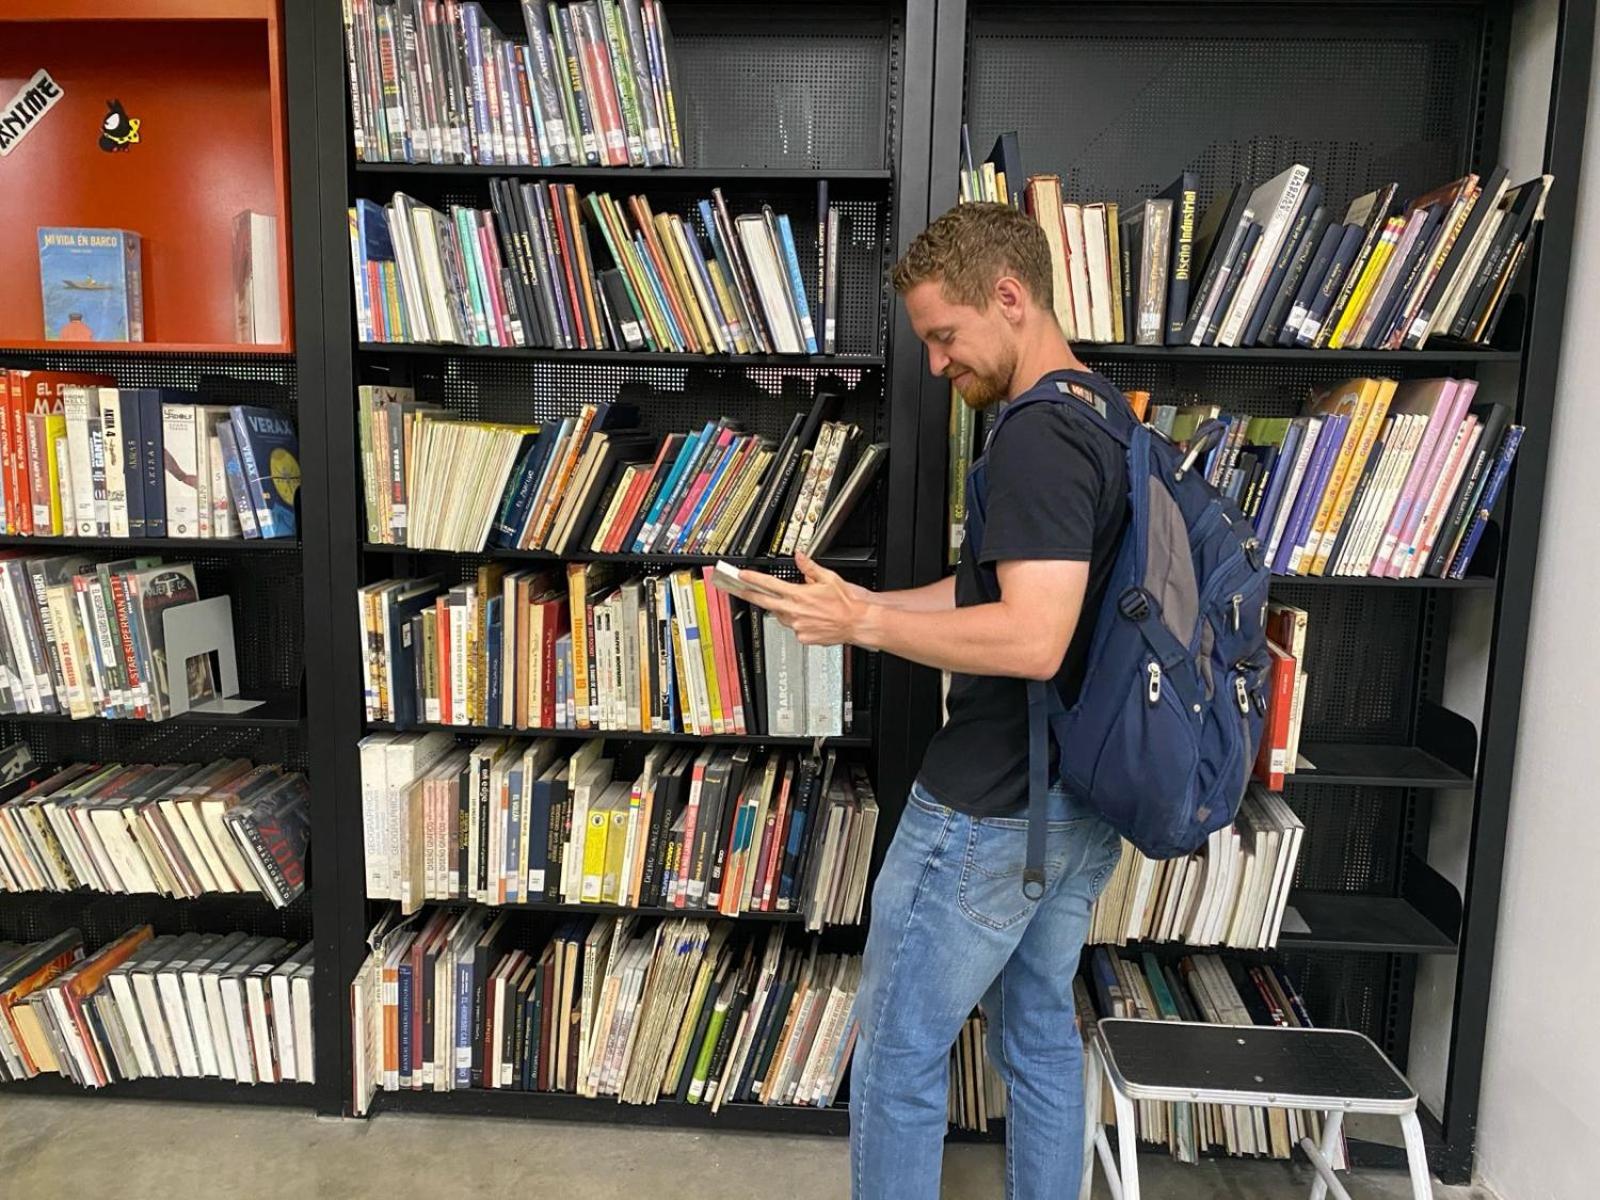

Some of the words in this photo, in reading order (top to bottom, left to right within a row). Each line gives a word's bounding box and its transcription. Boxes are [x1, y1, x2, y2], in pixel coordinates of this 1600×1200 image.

[401, 13, 416, 50] METAL
[566, 55, 582, 91] BATMAN
[0, 77, 60, 148] ANIME
[1179, 190, 1198, 243] Industrial
[44, 235, 55, 248] MI
[56, 234, 75, 247] VIDA
[77, 234, 89, 247] EN
[90, 235, 117, 247] BARCO
[818, 246, 824, 255] LA
[1175, 243, 1192, 281] Diseño
[34, 398, 64, 416] MA
[36, 383, 52, 396] EL
[103, 408, 115, 428] AKIRA
[247, 415, 293, 436] VERAX
[92, 430, 102, 467] GANTZ
[243, 445, 256, 475] VERAX
[1228, 448, 1239, 466] Papel
[147, 449, 155, 486] AKIRA
[32, 572, 48, 605] CORBEN
[40, 606, 56, 642] RICHARD
[114, 599, 135, 652] SUPERMAN
[571, 617, 587, 675] Illustrators
[126, 654, 139, 678] STAR
[480, 780, 488, 802] edge
[365, 790, 375, 855] GEOGRAPHICS
[390, 791, 399, 855] GEOGRAPHICS
[256, 845, 290, 899] MACDONALD
[400, 978, 408, 1010] EDITORIAL
